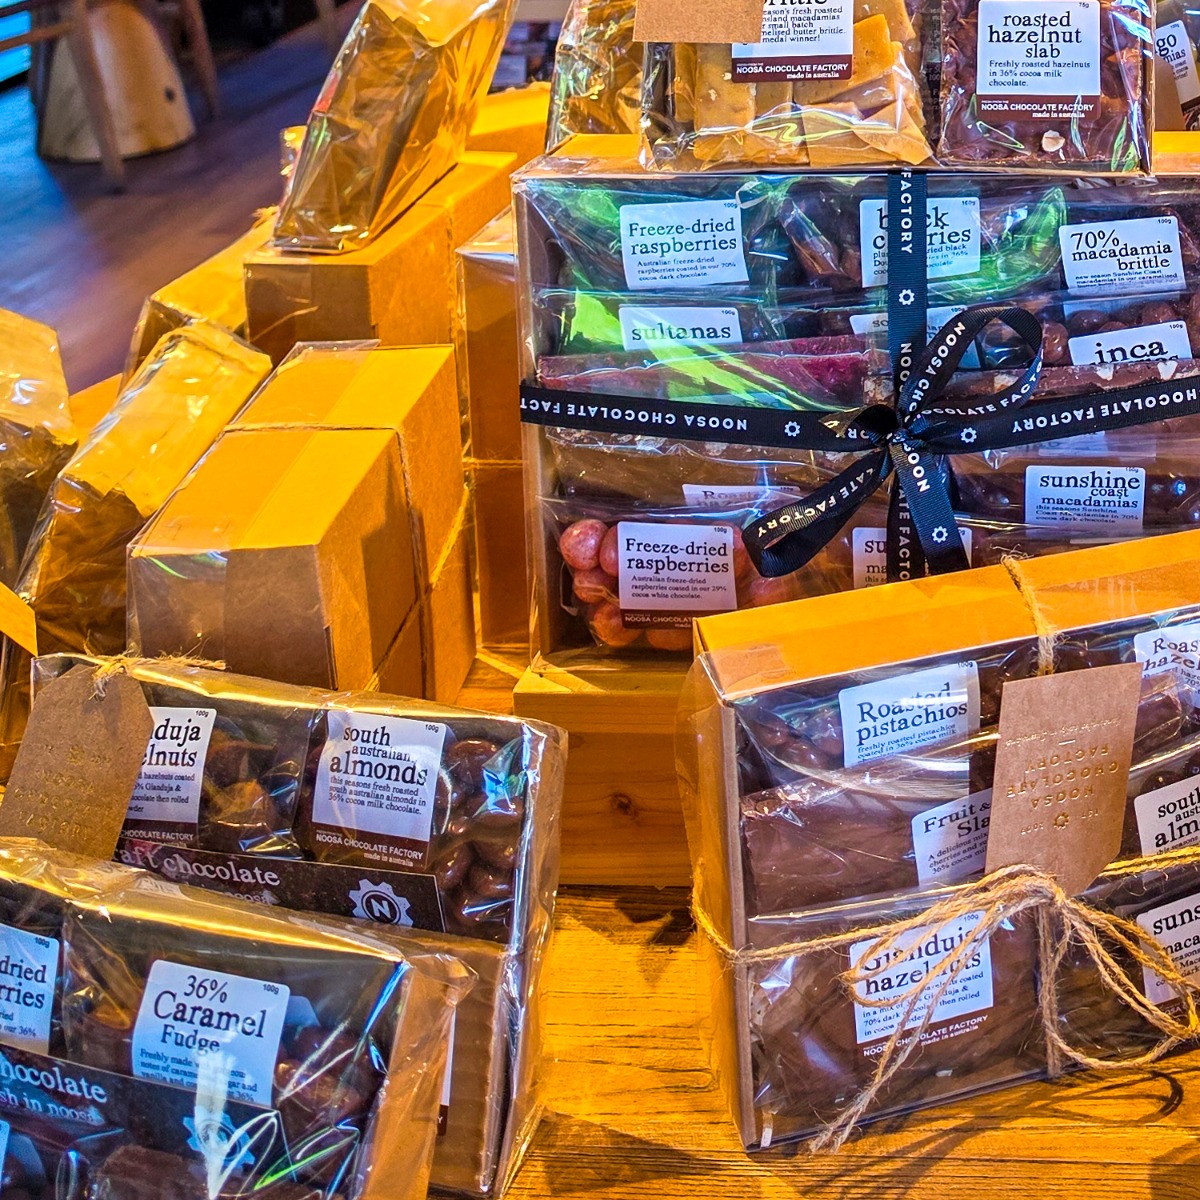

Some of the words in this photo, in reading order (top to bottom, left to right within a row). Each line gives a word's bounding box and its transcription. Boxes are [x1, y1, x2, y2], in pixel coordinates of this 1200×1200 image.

[814, 7, 843, 15] roasted
[1003, 11, 1071, 26] roasted
[769, 21, 788, 30] small
[792, 21, 813, 29] batch
[988, 25, 1082, 43] hazelnut
[1026, 44, 1060, 58] slab
[737, 66, 763, 74] NOOSA
[765, 65, 811, 73] CHOCOLATE
[989, 60, 1019, 68] Freshly
[901, 172, 912, 253] FACTORY
[629, 218, 735, 237] Freeze-dried
[631, 235, 736, 257] raspberries
[1070, 229, 1120, 250] 70%
[1072, 241, 1172, 261] macadamia
[1117, 255, 1170, 270] brittle
[632, 323, 731, 341] sultanas
[926, 322, 966, 376] NOOSA
[1095, 340, 1168, 364] inca
[567, 404, 676, 424] CHOCOLATE
[684, 415, 747, 430] NOOSA
[1012, 408, 1094, 433] FACTORY
[1040, 471, 1140, 489] sunshine
[1042, 496, 1138, 508] macadamias
[1091, 487, 1129, 499] coast
[758, 498, 836, 538] FACTORY
[626, 538, 728, 556] Freeze-dried
[627, 556, 729, 574] raspberries
[856, 702, 968, 746] pistachios
[343, 726, 391, 746] south
[352, 745, 410, 762] australian
[1025, 745, 1109, 774] FACTORY
[330, 751, 428, 786] almonds
[331, 776, 343, 784] this
[345, 778, 375, 789] seasons
[373, 782, 394, 793] fresh
[392, 787, 419, 797] roasted
[1006, 761, 1119, 799] CHOCOLATE
[155, 794, 170, 804] then
[171, 794, 189, 804] rolled
[329, 785, 347, 794] south
[349, 790, 385, 800] australian
[386, 794, 417, 806] almonds
[419, 798, 426, 806] in
[923, 803, 975, 833] Fruit
[979, 801, 991, 812] &
[162, 831, 193, 841] FACTORY
[316, 834, 343, 845] NOOSA
[344, 838, 387, 854] CHOCOLATE
[389, 846, 423, 859] FACTORY
[164, 851, 281, 886] chocolate
[183, 974, 229, 1004] 36%
[958, 991, 980, 1003] rolled
[153, 990, 268, 1038] Caramel
[949, 1015, 988, 1031] FACTORY
[160, 1024, 221, 1054] Fudge
